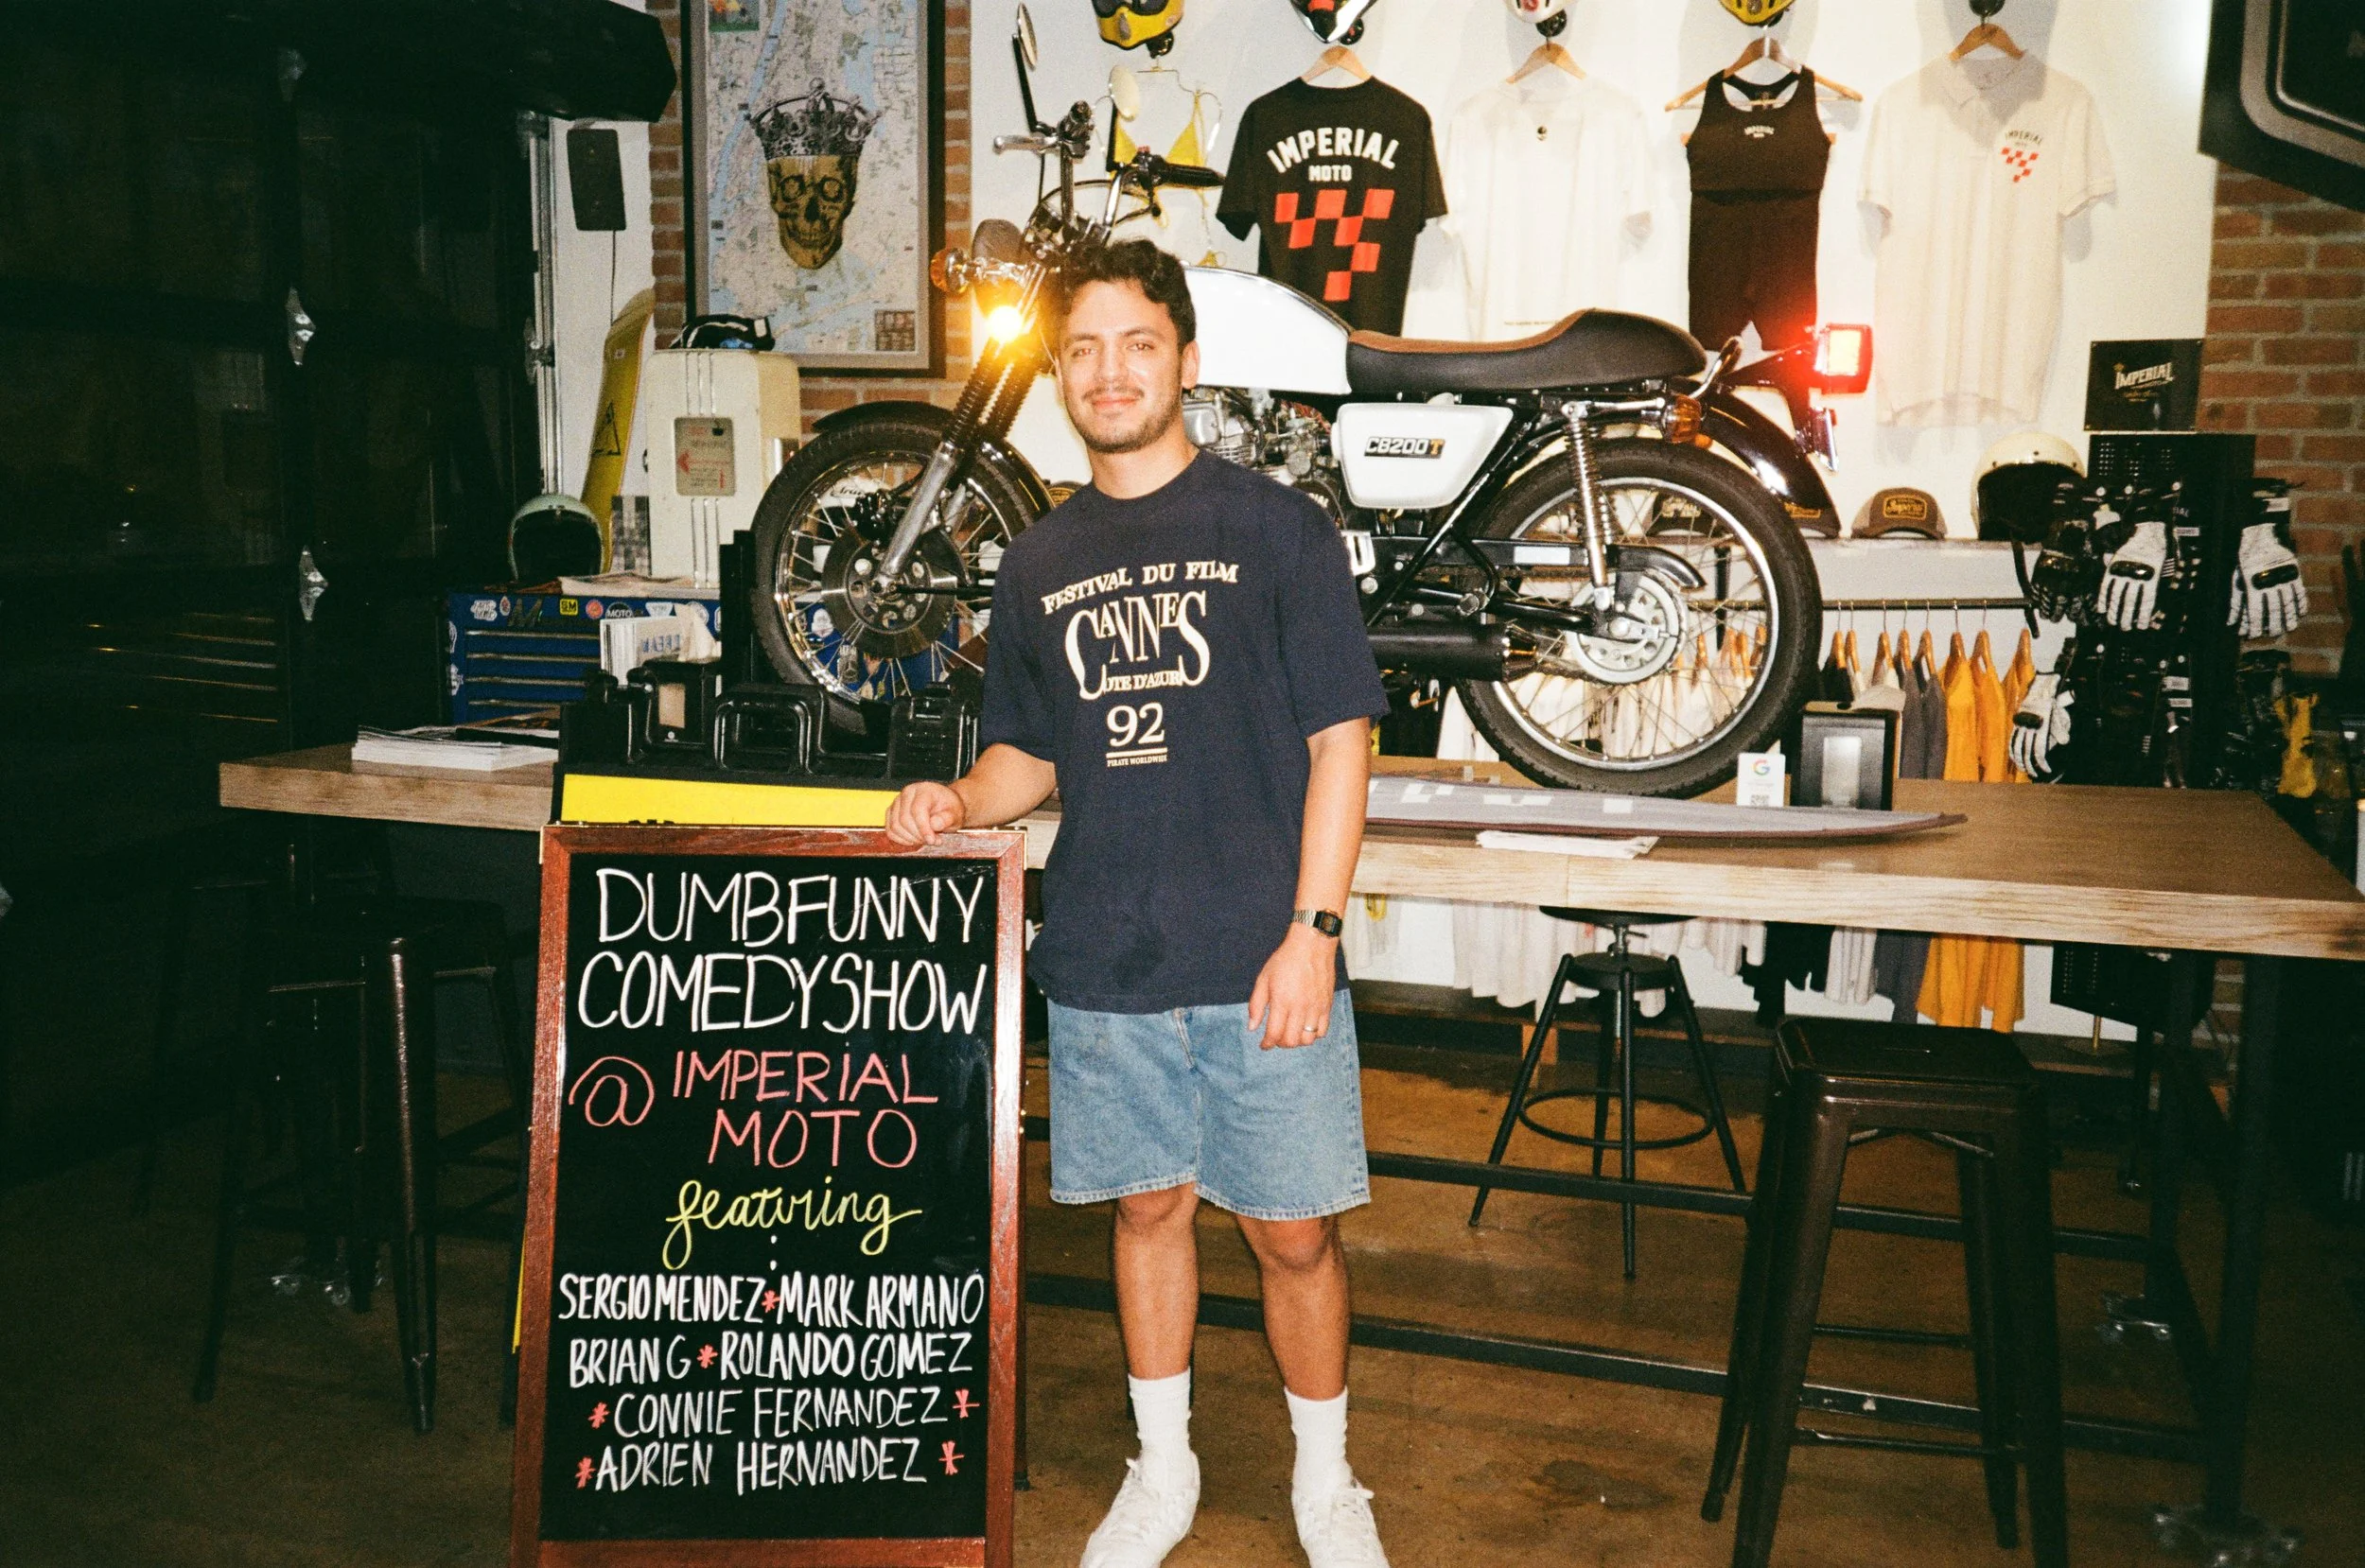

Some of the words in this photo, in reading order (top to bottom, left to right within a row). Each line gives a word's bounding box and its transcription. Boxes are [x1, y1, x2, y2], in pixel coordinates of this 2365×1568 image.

[1267, 127, 1399, 173] IMPERIAL
[1308, 165, 1352, 182] MOTO
[2115, 361, 2174, 390] IMPERIAL
[1365, 436, 1445, 457] CB200T
[1041, 567, 1132, 615] FESTIVAL
[1142, 563, 1177, 584] DU
[1185, 560, 1239, 583] FILM
[1064, 590, 1211, 700] CANNES
[1106, 702, 1165, 747] 92
[1106, 758, 1130, 767] PIRATE
[1130, 755, 1168, 765] WORLDWIDE
[568, 1055, 656, 1126] @
[673, 1048, 938, 1104] IMPERIAL
[707, 1108, 917, 1169] MOTO
[662, 1176, 923, 1270] featuring
[777, 1271, 865, 1329] MARK
[865, 1273, 985, 1330] ARMANO
[569, 1336, 660, 1388] BRIAN
[666, 1334, 692, 1381] G
[721, 1332, 856, 1381] ROLANDO
[860, 1333, 973, 1381] GOMEZ
[613, 1389, 743, 1438] CONNIE
[754, 1386, 949, 1437] FERNANDEZ
[595, 1443, 713, 1492] ADRIEN
[737, 1437, 927, 1495] HERNANDEZ
